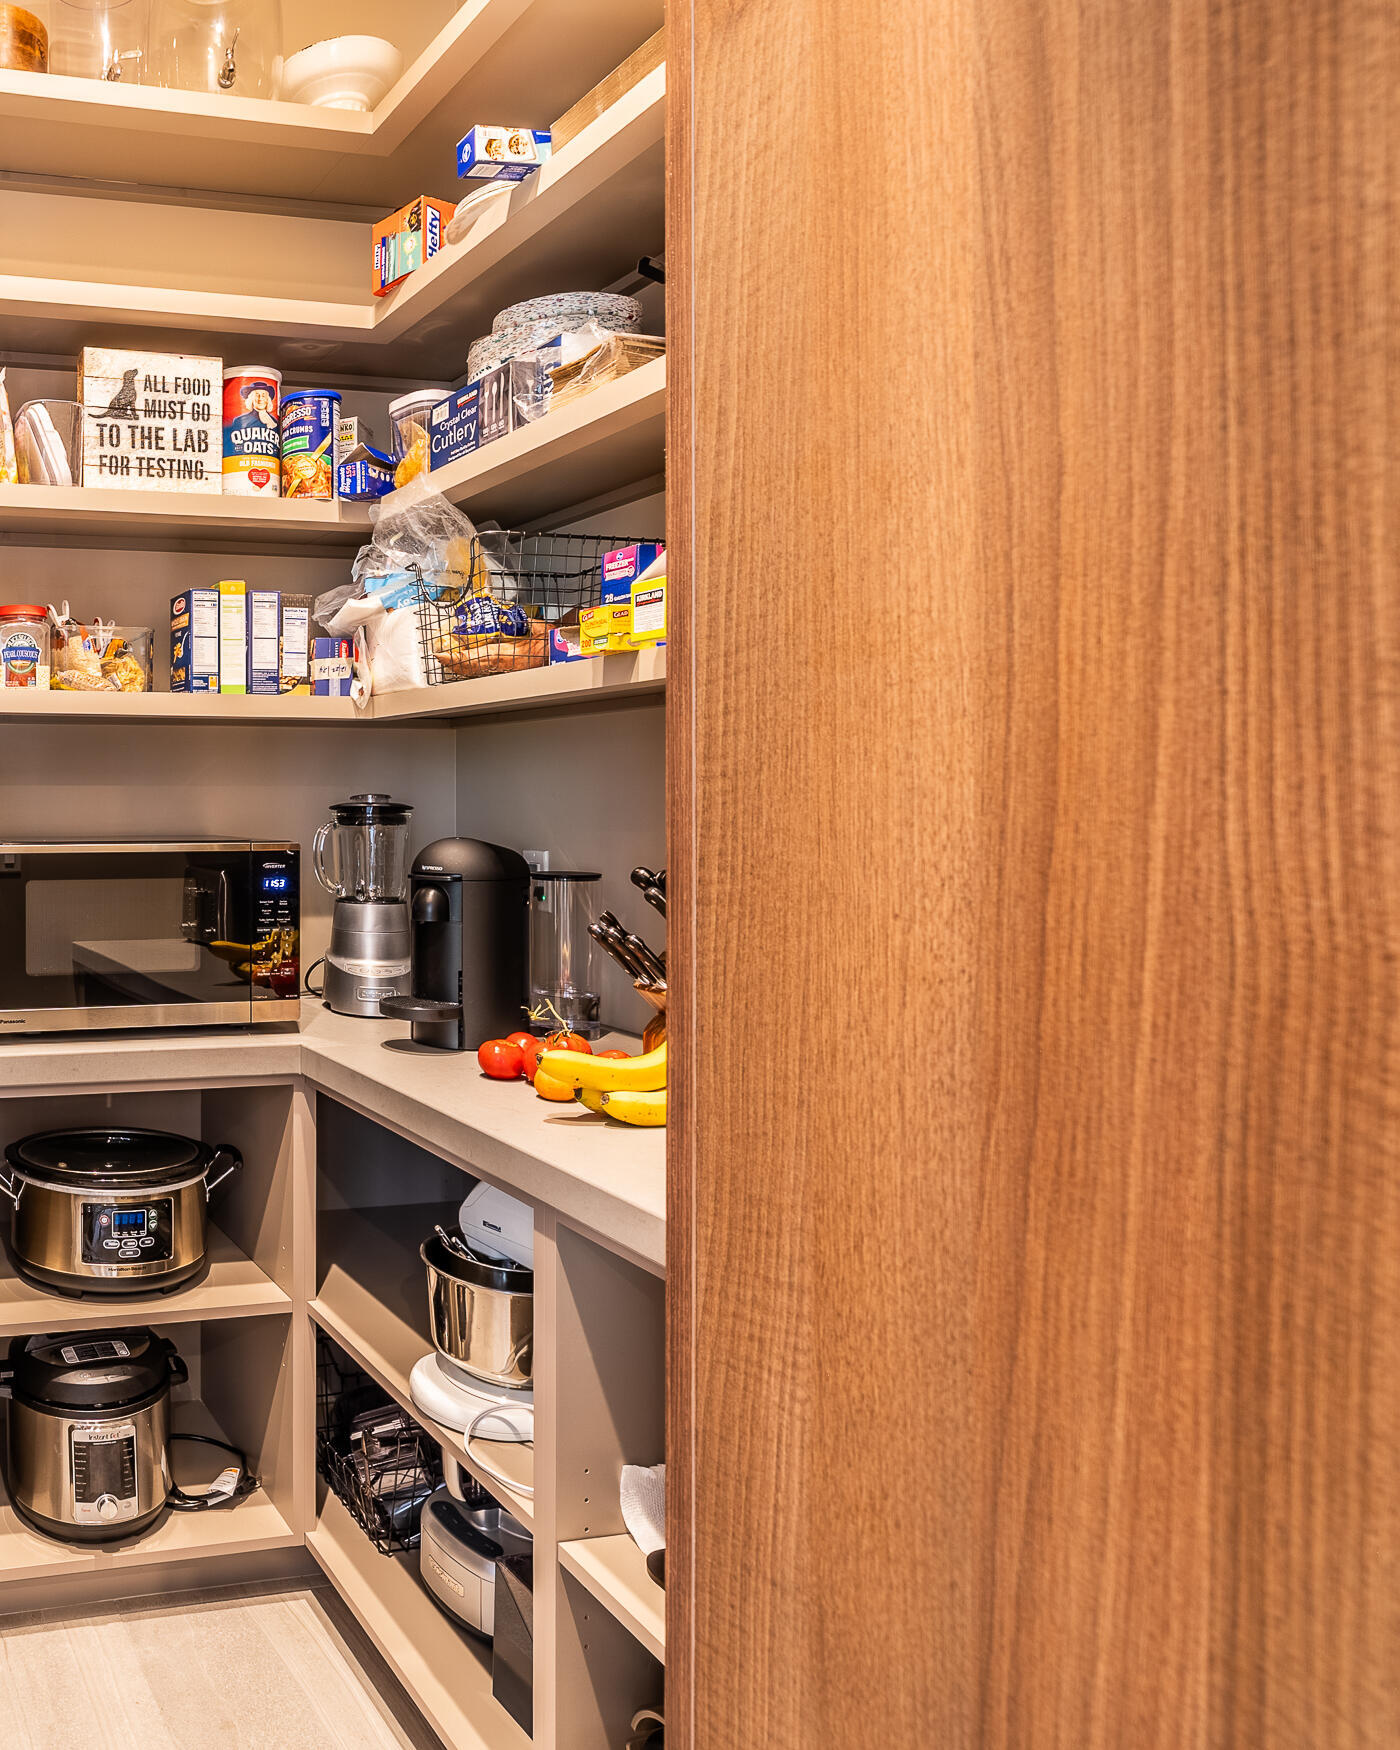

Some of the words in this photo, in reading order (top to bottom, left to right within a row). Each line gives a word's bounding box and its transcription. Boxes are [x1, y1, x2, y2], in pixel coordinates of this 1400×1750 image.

[428, 211, 440, 257] Hefty
[143, 374, 168, 395] ALL
[174, 377, 211, 397] FOOD
[143, 398, 186, 419] MUST
[191, 400, 211, 422] GO
[440, 413, 461, 432] Crystal
[460, 405, 478, 420] Clear
[289, 425, 314, 436] CRUMBS
[340, 423, 353, 432] NKO
[96, 422, 121, 451] TO
[128, 425, 166, 451] THE
[173, 428, 210, 454] LAB
[230, 427, 281, 448] QUAKER
[432, 420, 477, 453] Cutlery
[243, 441, 274, 454] OATS
[99, 454, 131, 478] FOR
[136, 457, 209, 481] TESTING.
[605, 560, 629, 572] FREEZER
[605, 593, 614, 603] 28
[636, 591, 663, 602] KIRKLAND
[614, 610, 629, 618] GLAD
[581, 639, 592, 648] 200
